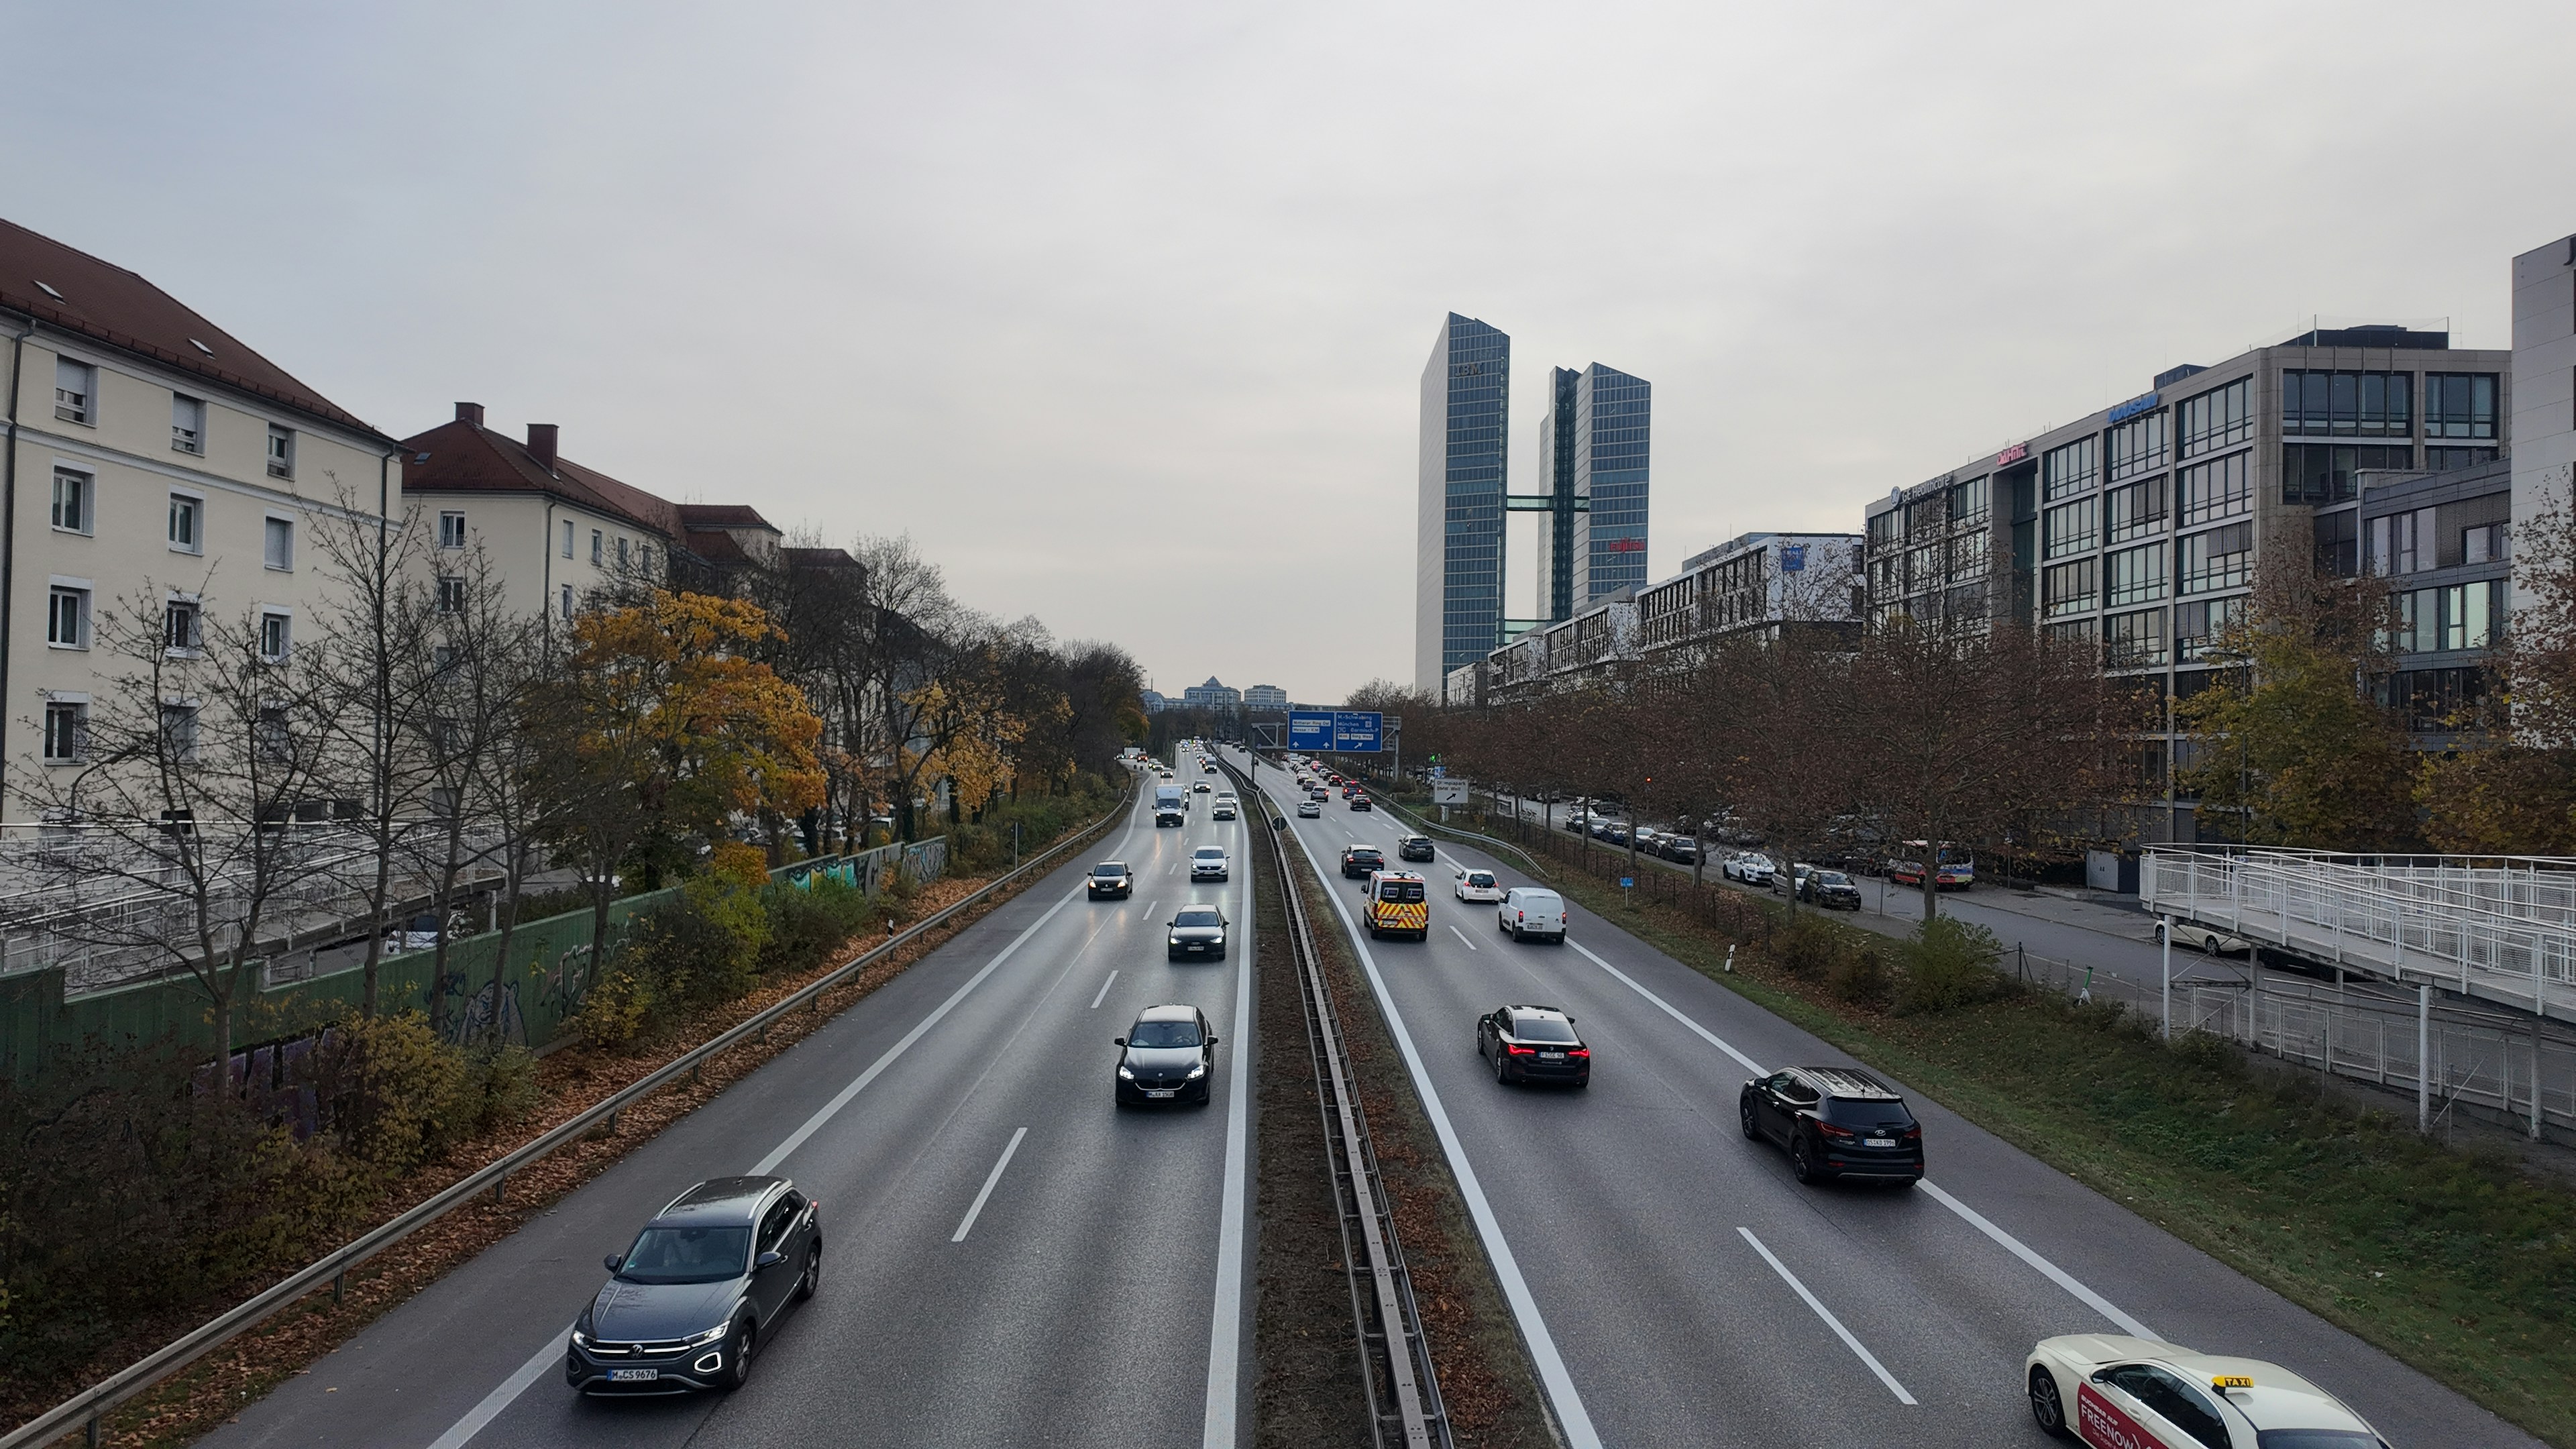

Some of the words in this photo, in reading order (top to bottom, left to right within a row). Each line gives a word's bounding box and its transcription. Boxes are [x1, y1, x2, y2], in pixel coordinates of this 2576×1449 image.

[1455, 363, 1483, 376] IBM
[1902, 489, 1911, 502] GE
[1912, 476, 1950, 499] Healthcare
[1610, 538, 1645, 553] FUJITSU
[635, 1370, 656, 1379] 9676
[2225, 1378, 2250, 1387] TAXI
[2081, 1394, 2106, 1417] BUCHBAR
[2107, 1415, 2118, 1426] AUF
[2081, 1403, 2134, 1449] FREENOW
